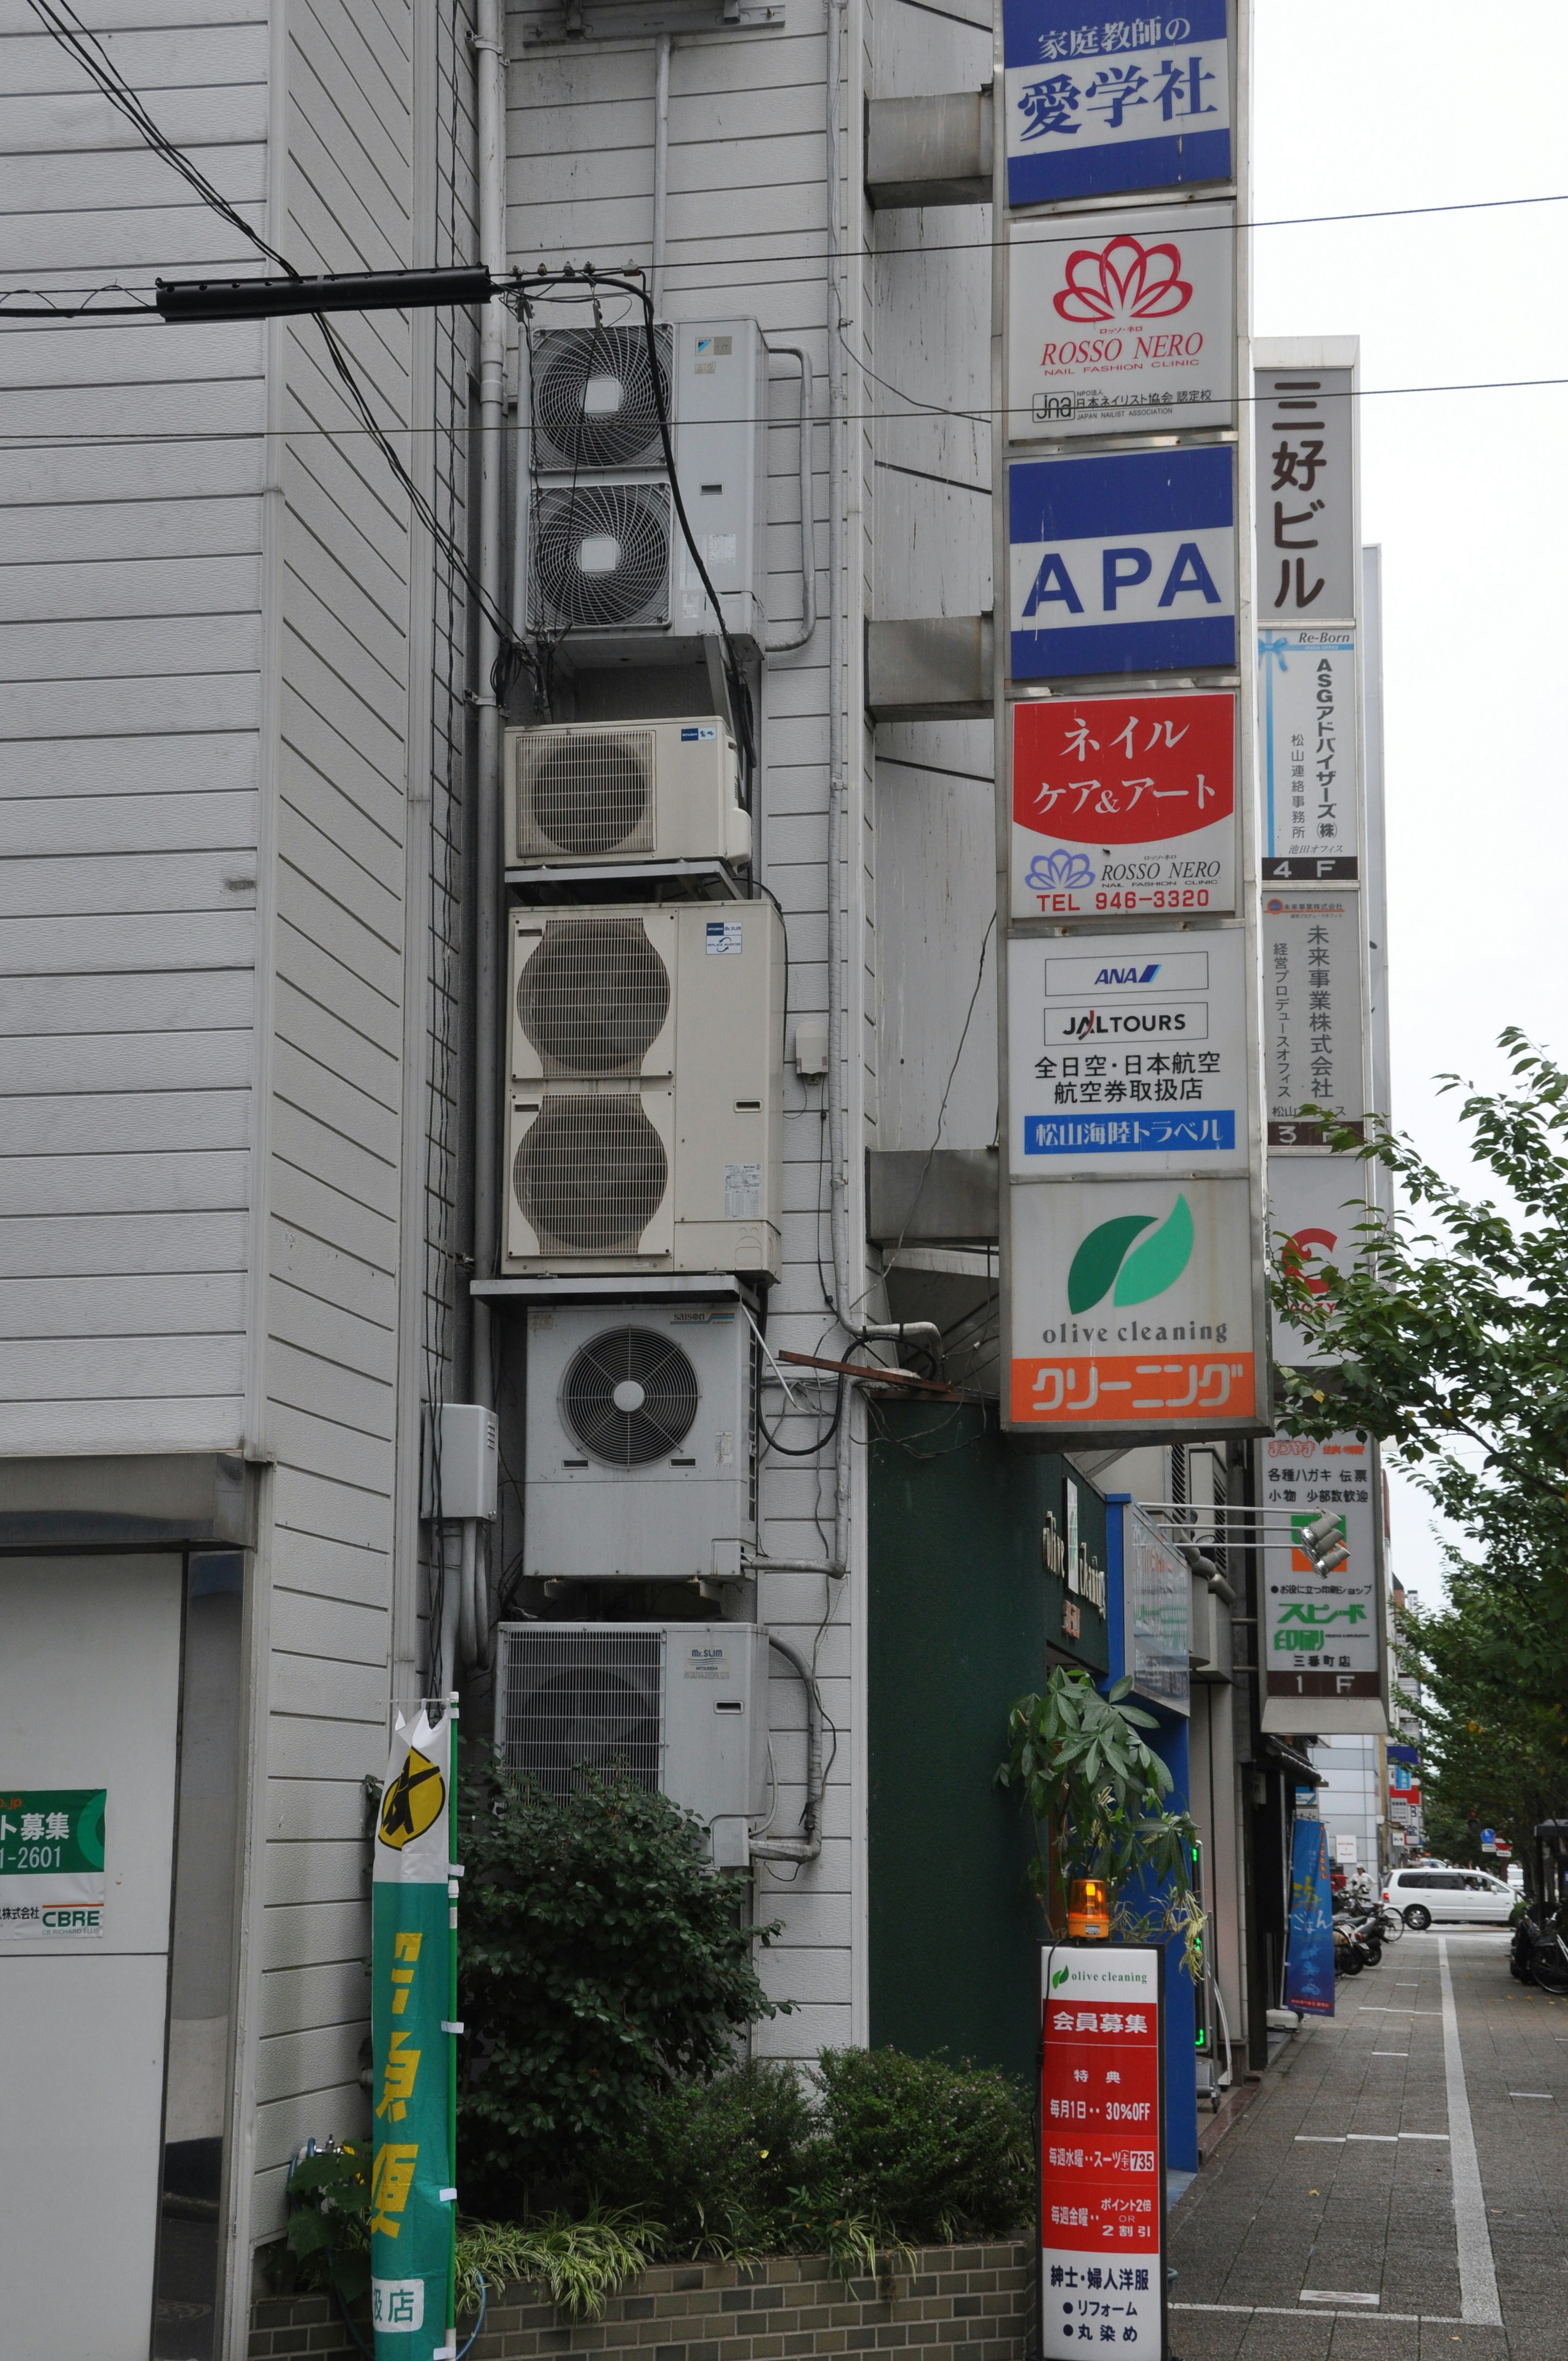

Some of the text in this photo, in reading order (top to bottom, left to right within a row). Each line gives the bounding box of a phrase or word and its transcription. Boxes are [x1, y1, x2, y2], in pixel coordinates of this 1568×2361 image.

[1038, 16, 1190, 59] 家庭教師の
[1018, 57, 1217, 142] 愛学社
[1100, 326, 1143, 334] ロッソ・ネロ
[1040, 332, 1203, 366] ROSSO NERO
[1084, 363, 1143, 372] FASHION
[1152, 359, 1199, 368] CLINIC
[1036, 395, 1071, 419] jna
[1077, 390, 1212, 408] 日本ネイリスト協会 認定校
[1271, 382, 1327, 608] 三好ビル
[1021, 543, 1222, 617] APA
[1299, 633, 1350, 643] Re-Born
[1059, 716, 1190, 762] ネイル
[1033, 774, 1215, 815] ケア&アート
[1291, 734, 1305, 840] 松山連絡事務所
[1288, 844, 1343, 855] 池田オフィス
[1100, 861, 1221, 881] ROSSO NERO
[1037, 889, 1209, 912] TEL 946-3320
[1094, 967, 1139, 984] ANA
[1273, 942, 1291, 1098] 経営プロデュースオフィス
[1307, 924, 1334, 1098] 未来事業株式会社
[1034, 1051, 1221, 1079] 全日空・日本航空
[1054, 1078, 1203, 1104] 航空券取扱店
[1036, 1119, 1223, 1147] 松山海陸トラベル
[1042, 1321, 1227, 1343] olive cleaning
[1032, 1363, 1243, 1410] クリーニング
[1268, 1468, 1367, 1482] 各種ハガキ 伝票
[1269, 1489, 1368, 1502] 小物 少部数歓迎
[1277, 1604, 1367, 1624] スピード
[1274, 1630, 1324, 1651] 印刷
[1294, 1655, 1350, 1667] 三番町店
[0, 1812, 69, 1841] ト募集
[42, 1911, 100, 1927] CBRE
[1072, 1971, 1147, 1985] olive cleaning
[1053, 2011, 1147, 2034] 会員募集
[1106, 2102, 1150, 2121] 30%OFF
[1101, 2198, 1152, 2212] ポイント2倍
[1102, 2225, 1151, 2237] 2割引
[1051, 2265, 1149, 2291] 紳士・婦人洋服
[1078, 2300, 1138, 2317] リフォーム
